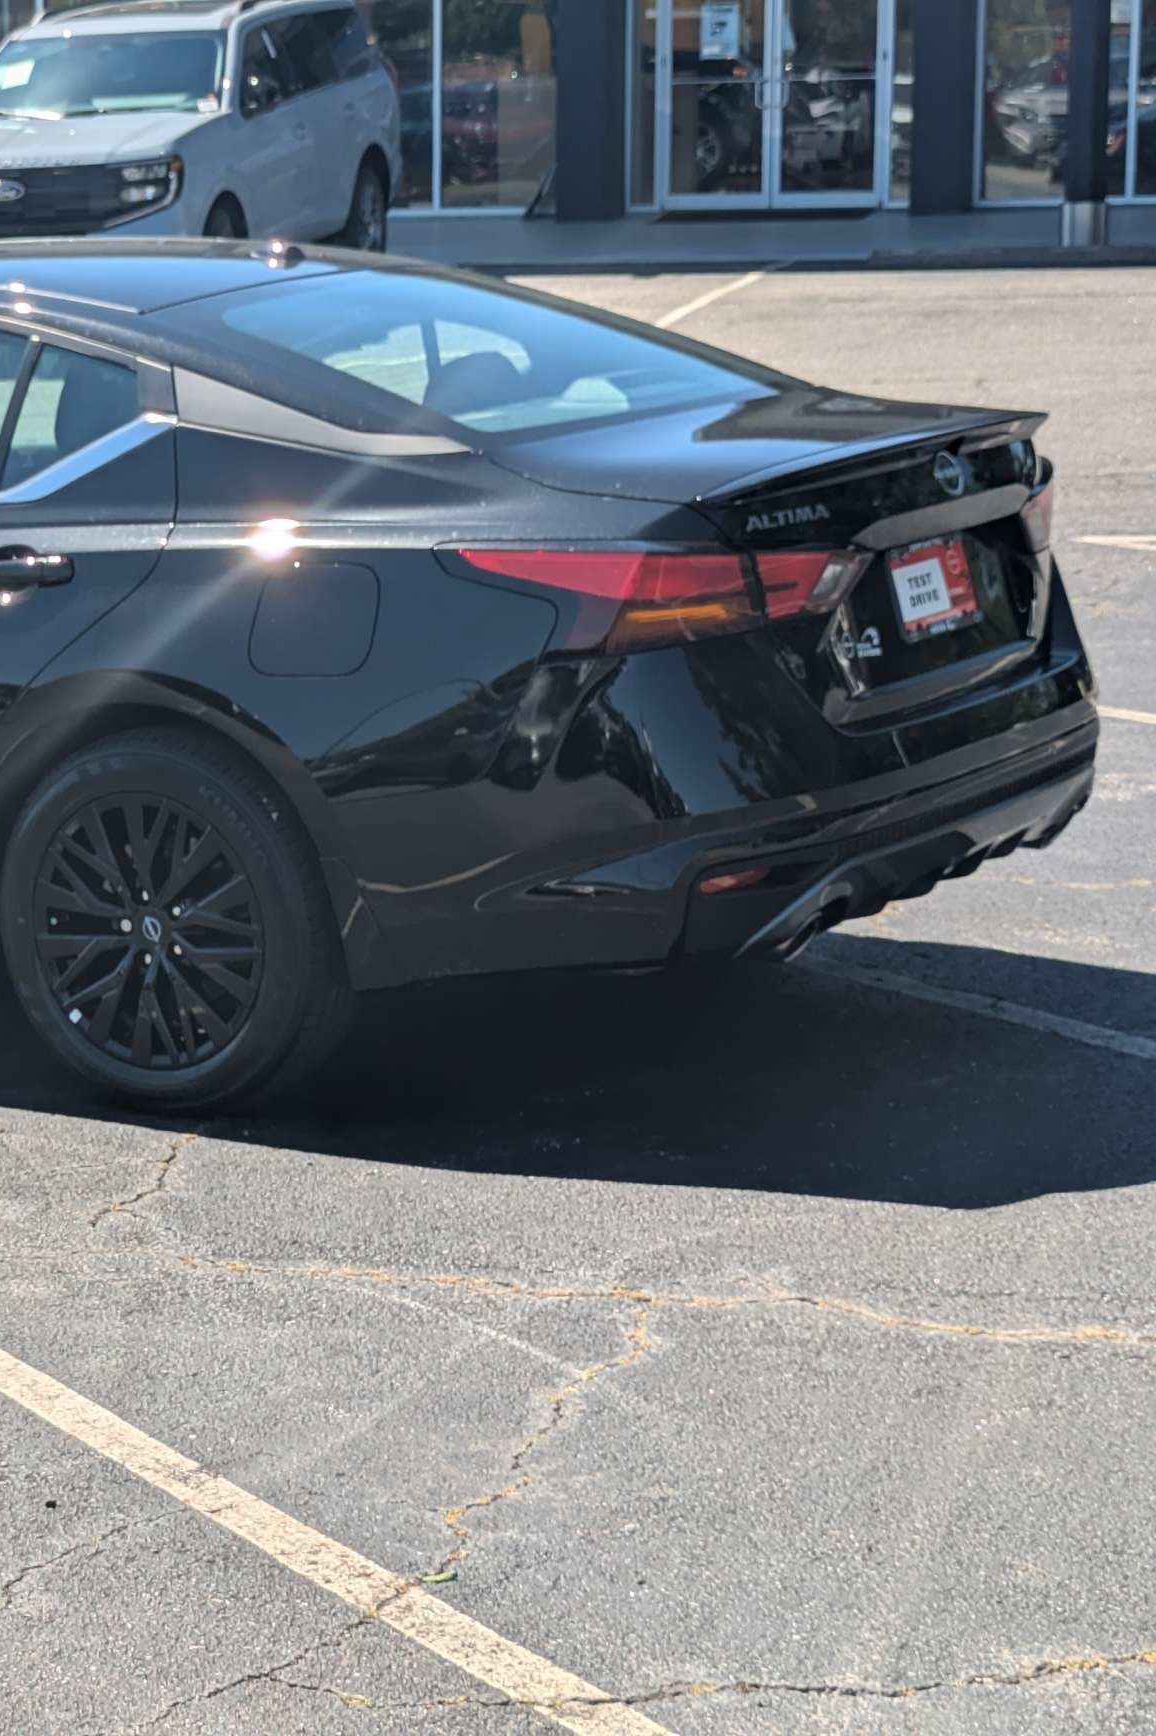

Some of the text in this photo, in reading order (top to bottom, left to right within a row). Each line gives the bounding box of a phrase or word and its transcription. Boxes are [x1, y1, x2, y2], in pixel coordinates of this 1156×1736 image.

[746, 504, 830, 532] ALTIMA
[907, 572, 932, 591] TEST
[909, 589, 940, 608] DRIVE
